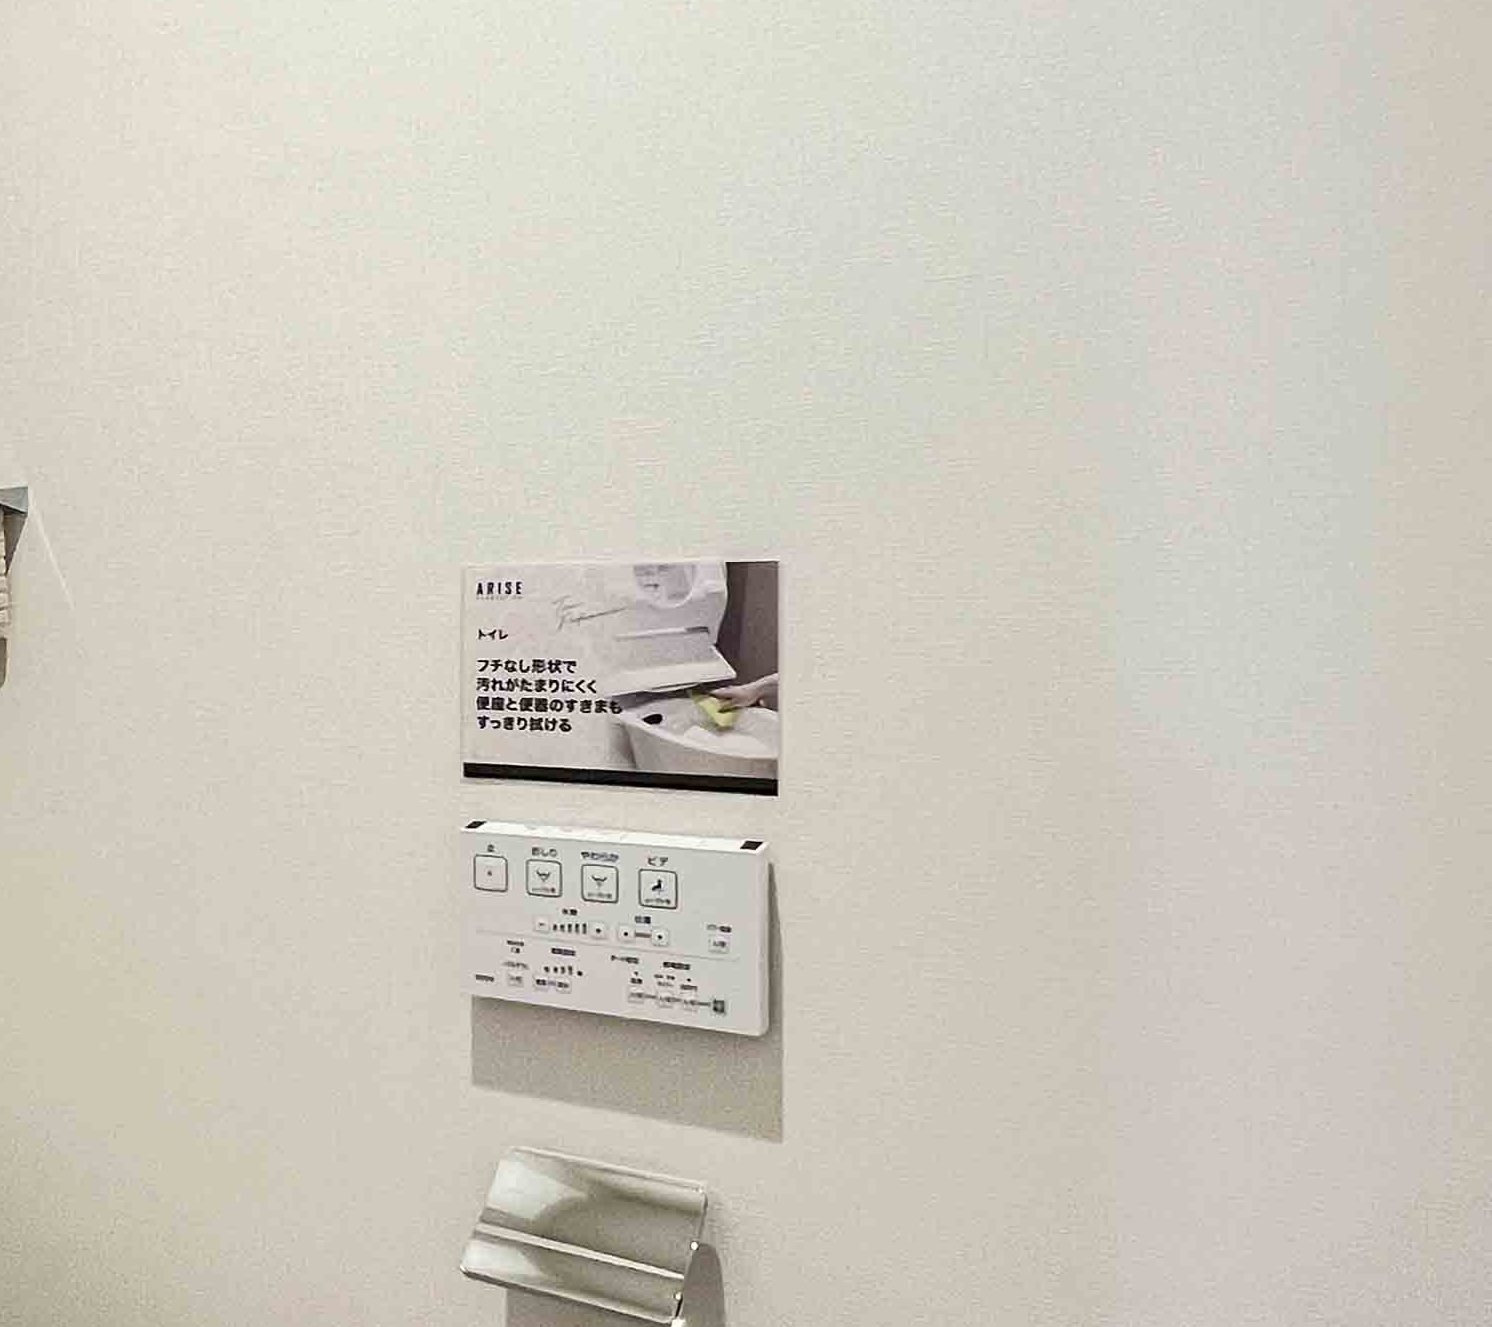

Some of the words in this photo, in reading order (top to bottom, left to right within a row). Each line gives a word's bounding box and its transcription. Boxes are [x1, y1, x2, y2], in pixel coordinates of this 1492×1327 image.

[476, 581, 523, 595] ARISE
[477, 628, 509, 641] トイレ
[476, 658, 577, 674] フチなし形状で
[475, 677, 597, 694] 汚れがたまりにくく
[476, 695, 623, 715] 便座と便器のすきまも
[476, 715, 573, 733] すっきり拭ける
